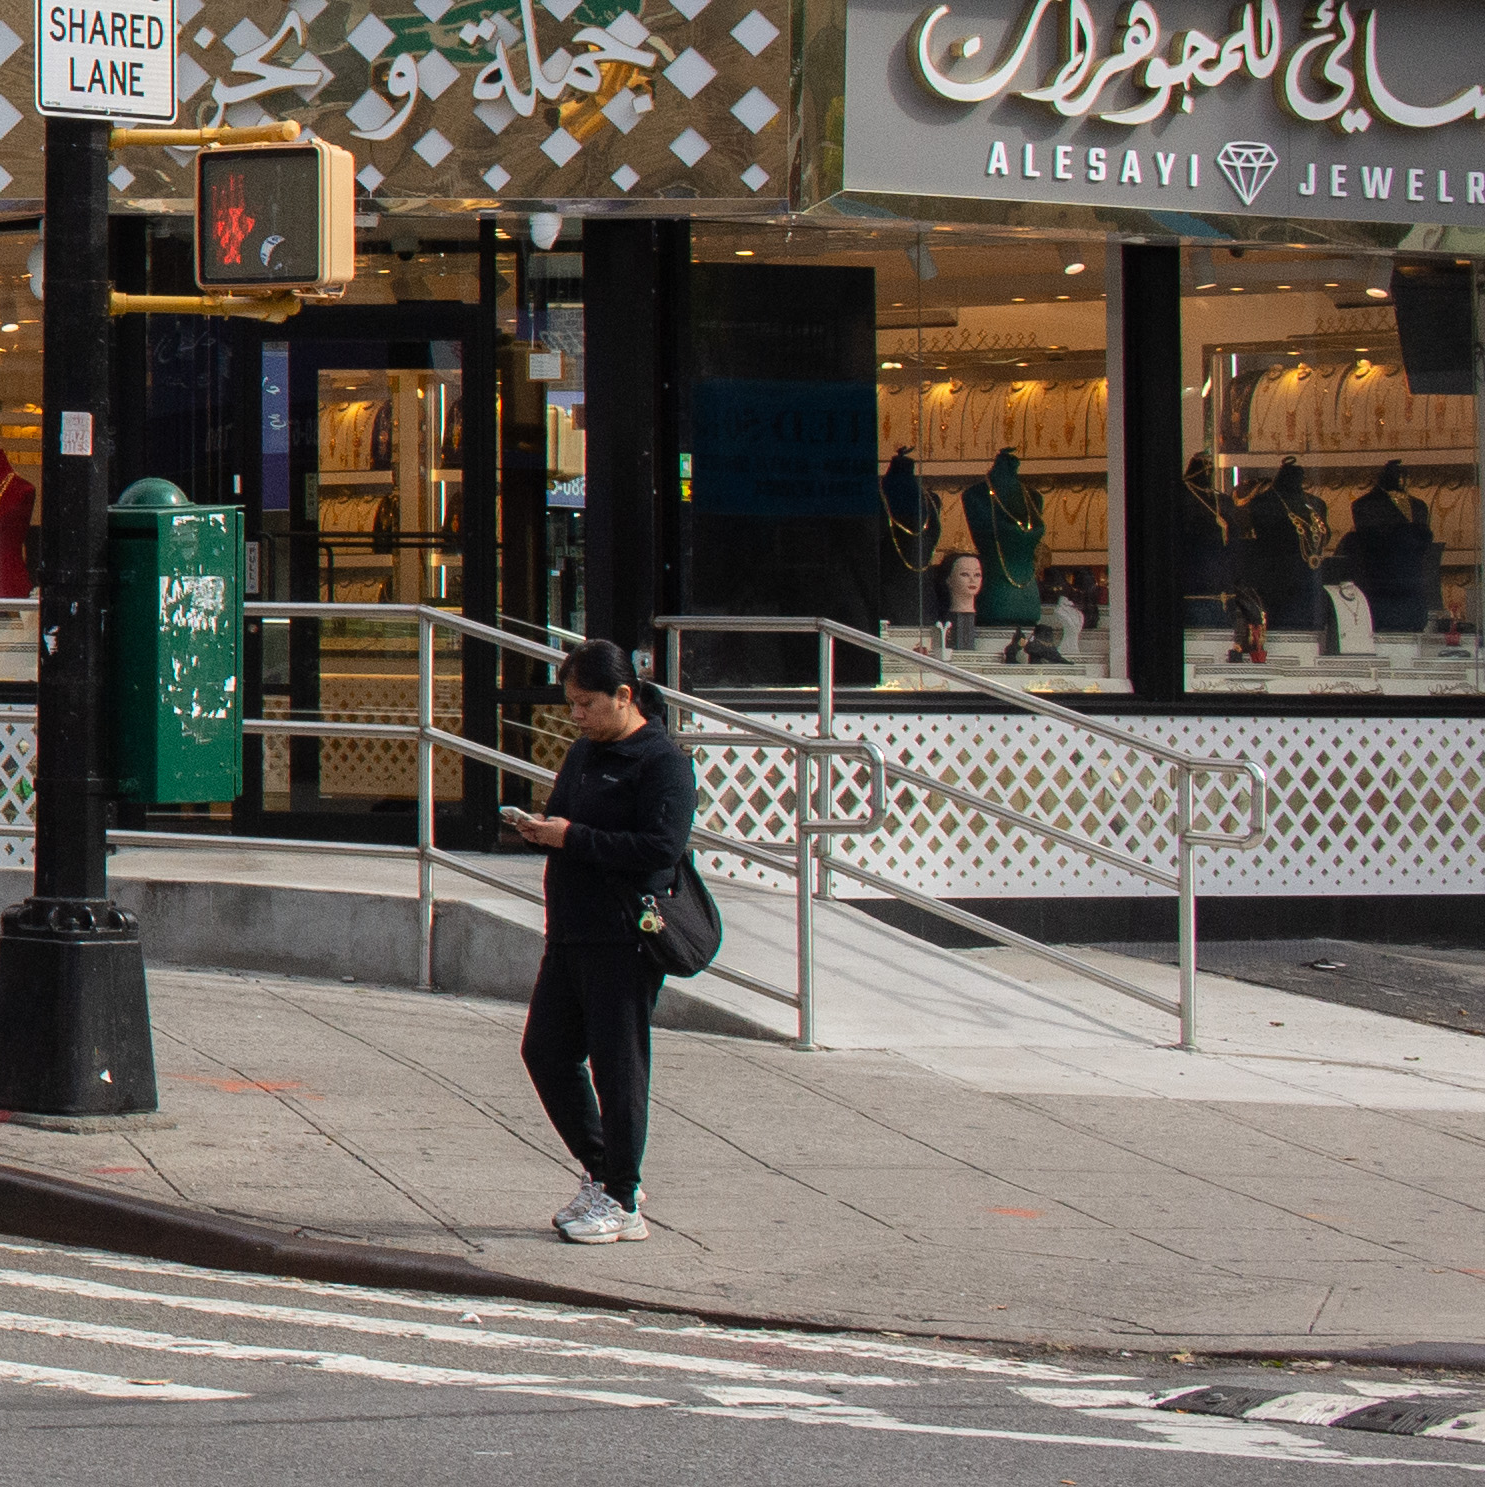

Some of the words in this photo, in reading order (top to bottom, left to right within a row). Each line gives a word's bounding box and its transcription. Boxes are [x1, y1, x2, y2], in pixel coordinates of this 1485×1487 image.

[50, 7, 164, 50] SHARED
[68, 56, 145, 97] LANE
[986, 140, 1199, 188] ALESAYI
[1298, 162, 1485, 205] JEWELR
